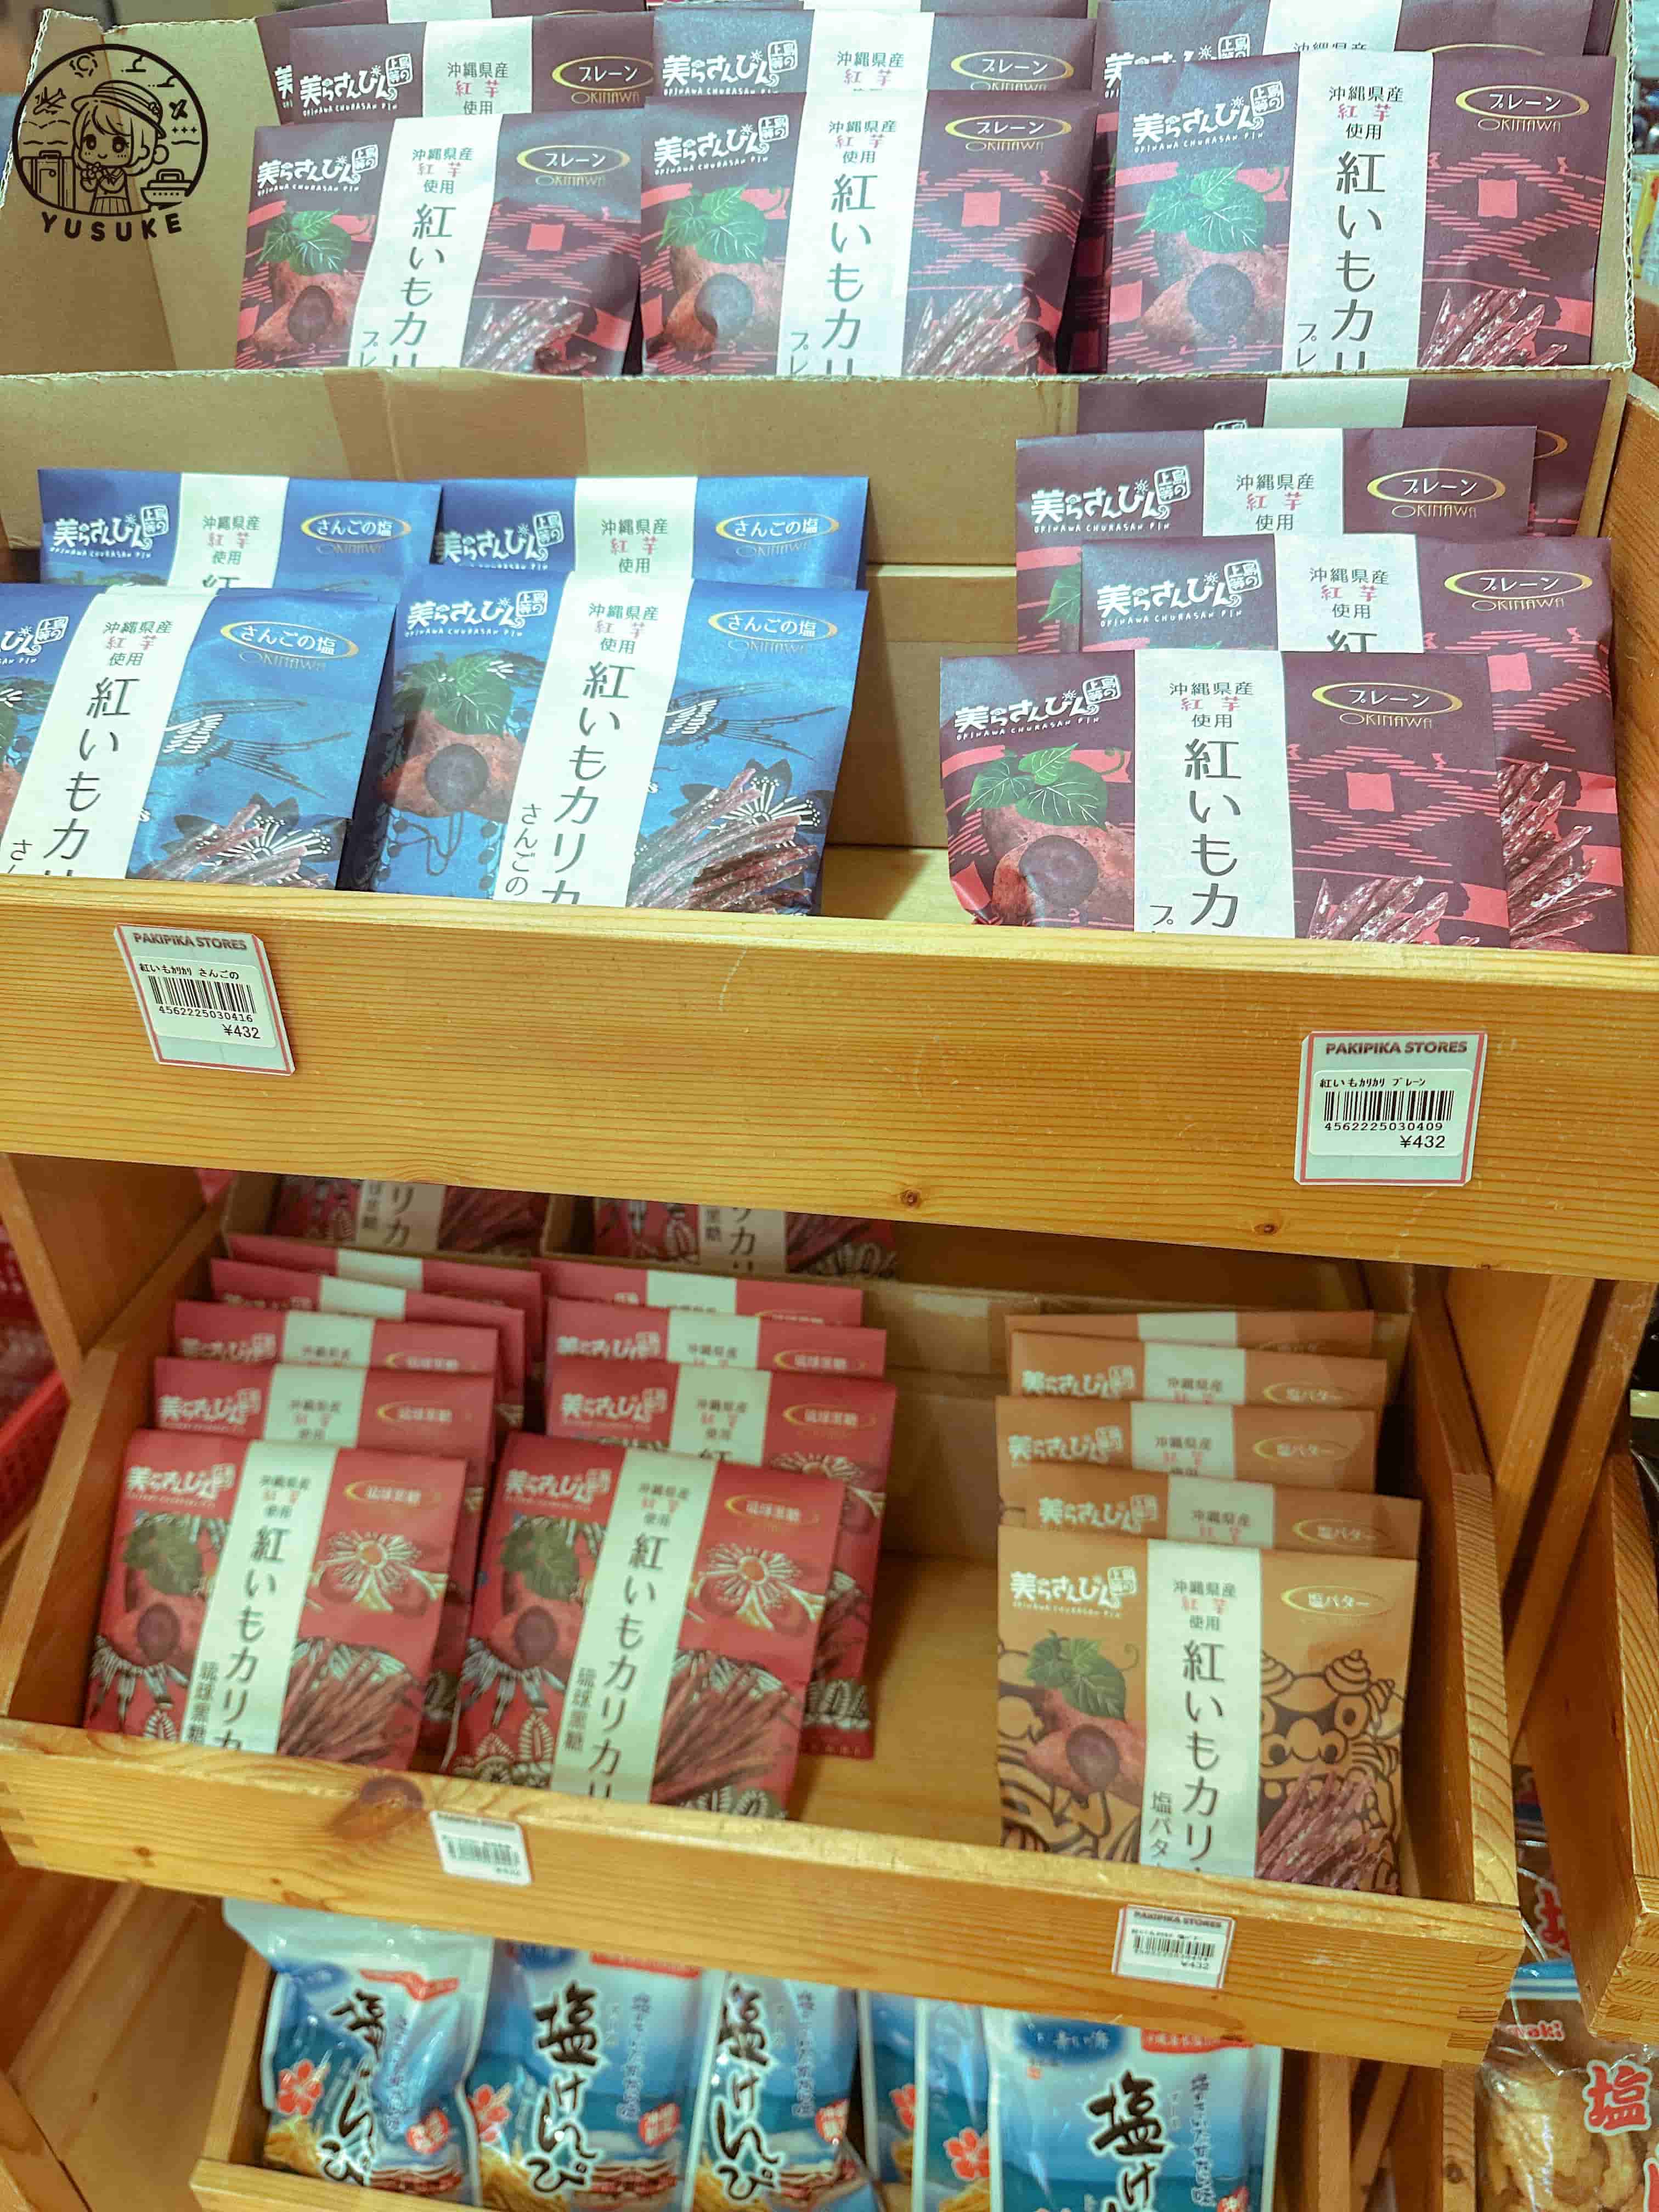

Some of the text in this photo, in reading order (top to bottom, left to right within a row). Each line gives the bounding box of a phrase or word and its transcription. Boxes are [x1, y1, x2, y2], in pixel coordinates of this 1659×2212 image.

[837, 51, 904, 68] 沖縄県産
[982, 59, 1048, 75] プレーン
[448, 61, 509, 78] 沖縄県産
[579, 66, 638, 83] プレーン
[1328, 86, 1403, 103] 沖縄県産
[1489, 93, 1561, 112] プレーン
[464, 101, 493, 115] 使用
[829, 120, 897, 132] 沖縄県産
[977, 121, 1043, 135] プレーン
[1346, 123, 1381, 140] 使用
[413, 148, 474, 161] 沖縄県産
[545, 153, 606, 167] プレーン
[843, 150, 876, 164] 使用
[424, 180, 454, 195] 使用
[1236, 474, 1314, 491] 沖縄県産
[1403, 478, 1477, 496] プレーン
[203, 516, 261, 531] 沖縄県産
[317, 520, 393, 537] さんごの塩
[601, 519, 668, 535] 沖縄県産
[733, 519, 817, 537] さんごの塩
[1256, 514, 1294, 531] 使用
[212, 551, 241, 565] 使用
[618, 557, 650, 573] 使用
[1310, 567, 1390, 585] 沖縄県産
[1480, 577, 1559, 592] プレーン
[589, 604, 659, 620] 沖縄県産
[1332, 604, 1370, 619] 使用
[103, 621, 173, 634] 沖縄県産
[728, 615, 816, 637] さんごの塩
[240, 625, 336, 654] さんごの塩
[601, 638, 635, 654] 使用
[109, 653, 144, 666] 使用
[1170, 681, 1254, 696] 沖縄県産
[1348, 690, 1429, 707] プレーン
[1192, 714, 1233, 727] 使用
[44, 678, 140, 876] 紅いもカ
[1184, 738, 1242, 928] 紅いもカ
[8, 839, 32, 873] さ
[506, 804, 541, 895] さんごの
[133, 933, 246, 950] PAKIPIKA STORES
[199, 969, 239, 980] さんごの
[159, 1006, 253, 1022] 4562225030416
[222, 1025, 260, 1039] ¥432
[1326, 1041, 1468, 1054] PAKIPIKA STORES
[1324, 1122, 1443, 1131] 4562225030409
[1400, 1135, 1445, 1148] ¥432
[526, 1980, 598, 2193] 塩けんぴ
[1587, 2064, 1649, 2131] 塩
[1088, 2071, 1167, 2212] 塩け
